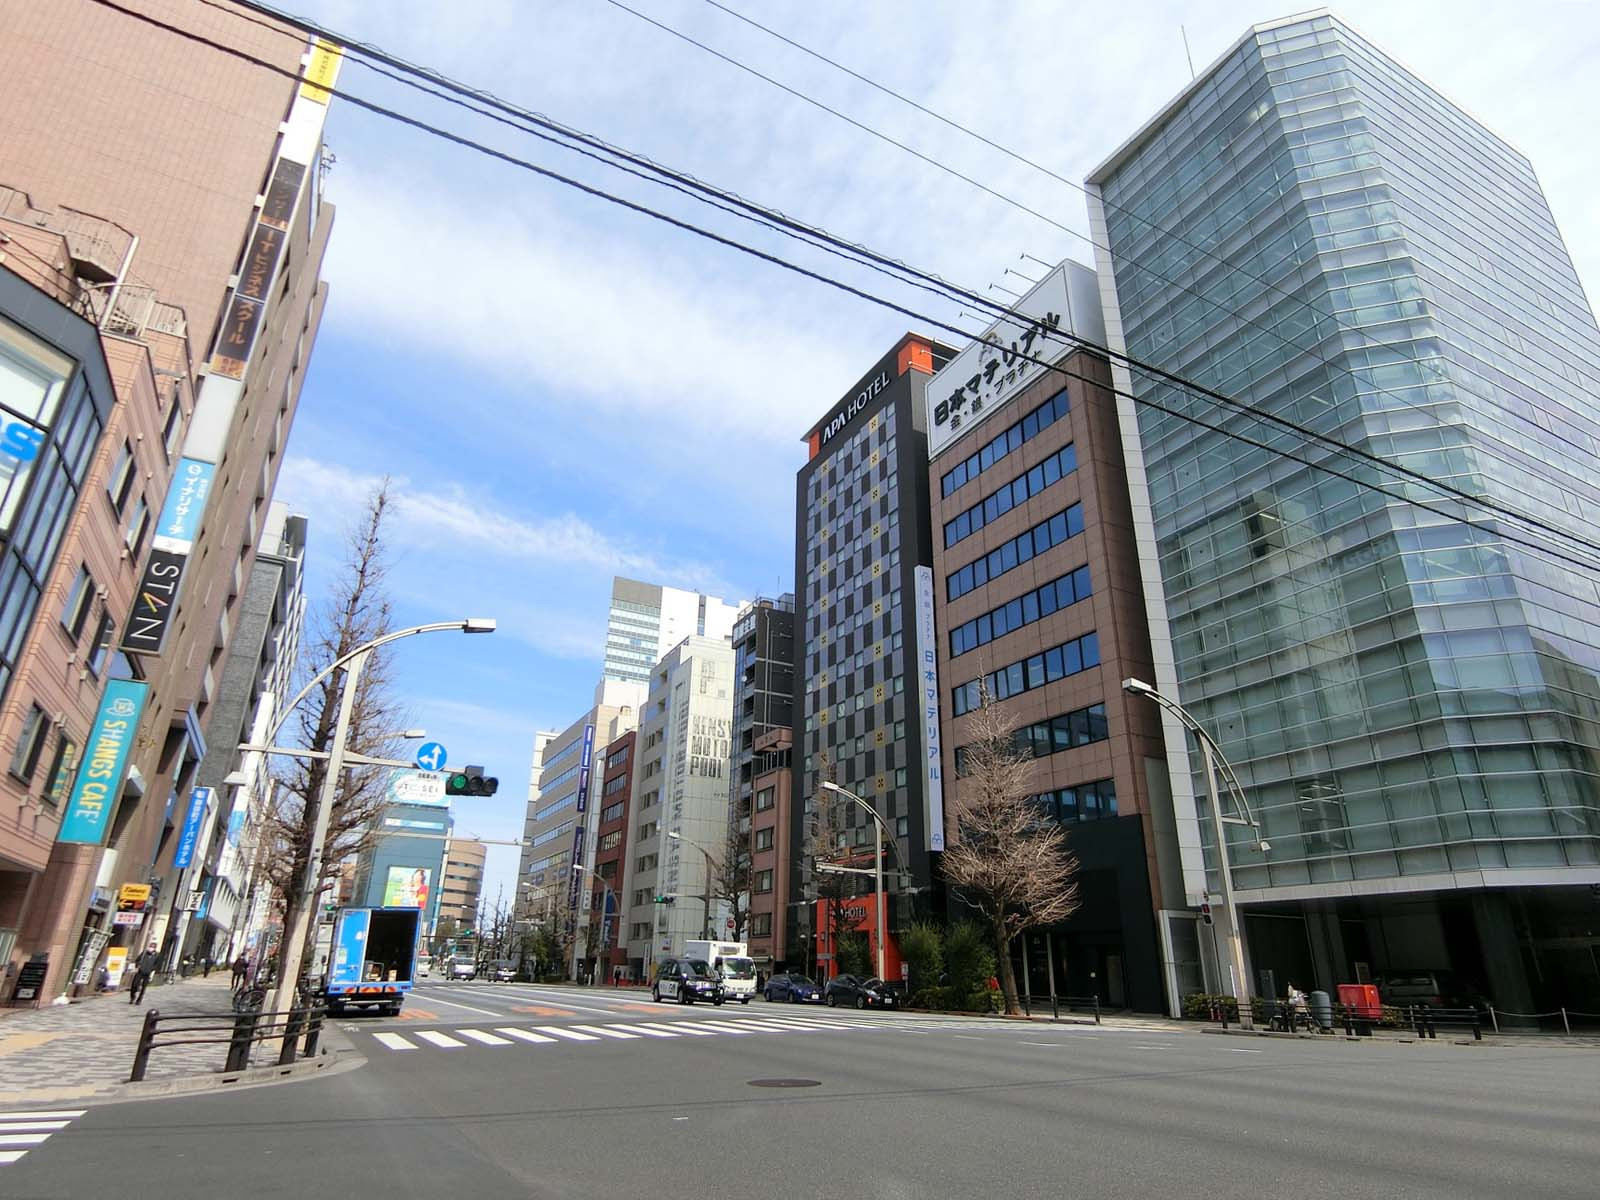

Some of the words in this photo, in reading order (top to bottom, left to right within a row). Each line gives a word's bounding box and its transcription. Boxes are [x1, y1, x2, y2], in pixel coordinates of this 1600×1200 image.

[934, 312, 1060, 426] 日本マテリアル
[823, 412, 846, 444] APA
[848, 372, 890, 421] HOTEL
[130, 561, 180, 641] STAN
[87, 719, 128, 779] SHANGS
[924, 649, 940, 781] 日本マテリアル
[845, 906, 866, 919] HOTEL
